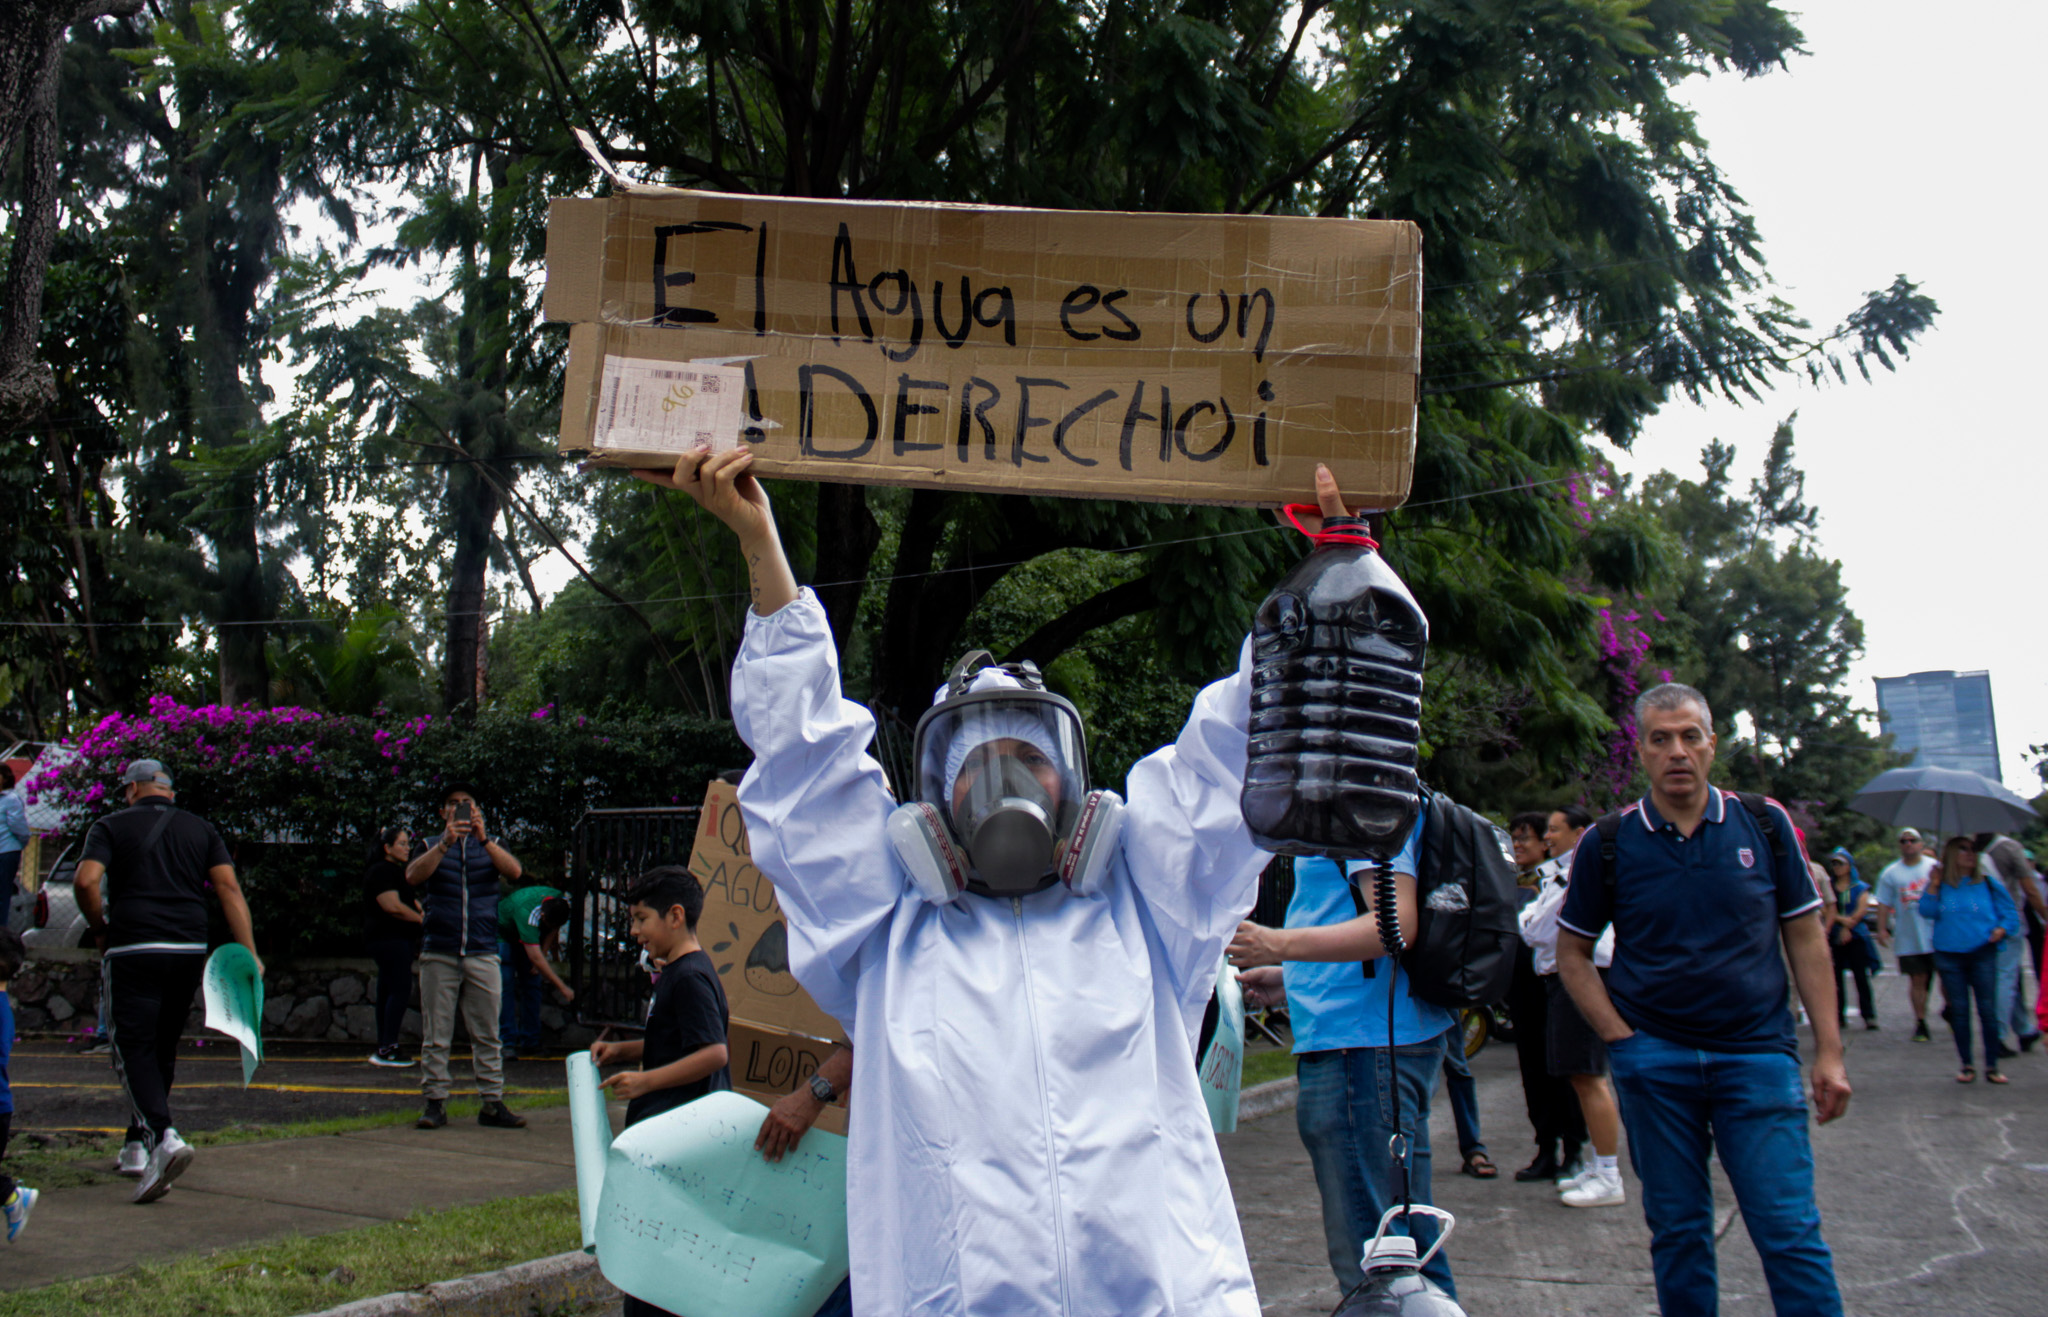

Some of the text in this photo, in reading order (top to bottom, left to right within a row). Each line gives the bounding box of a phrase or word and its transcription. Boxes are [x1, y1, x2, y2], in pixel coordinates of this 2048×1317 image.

[654, 220, 1276, 363] El Agua es un
[704, 862, 780, 914] AGU
